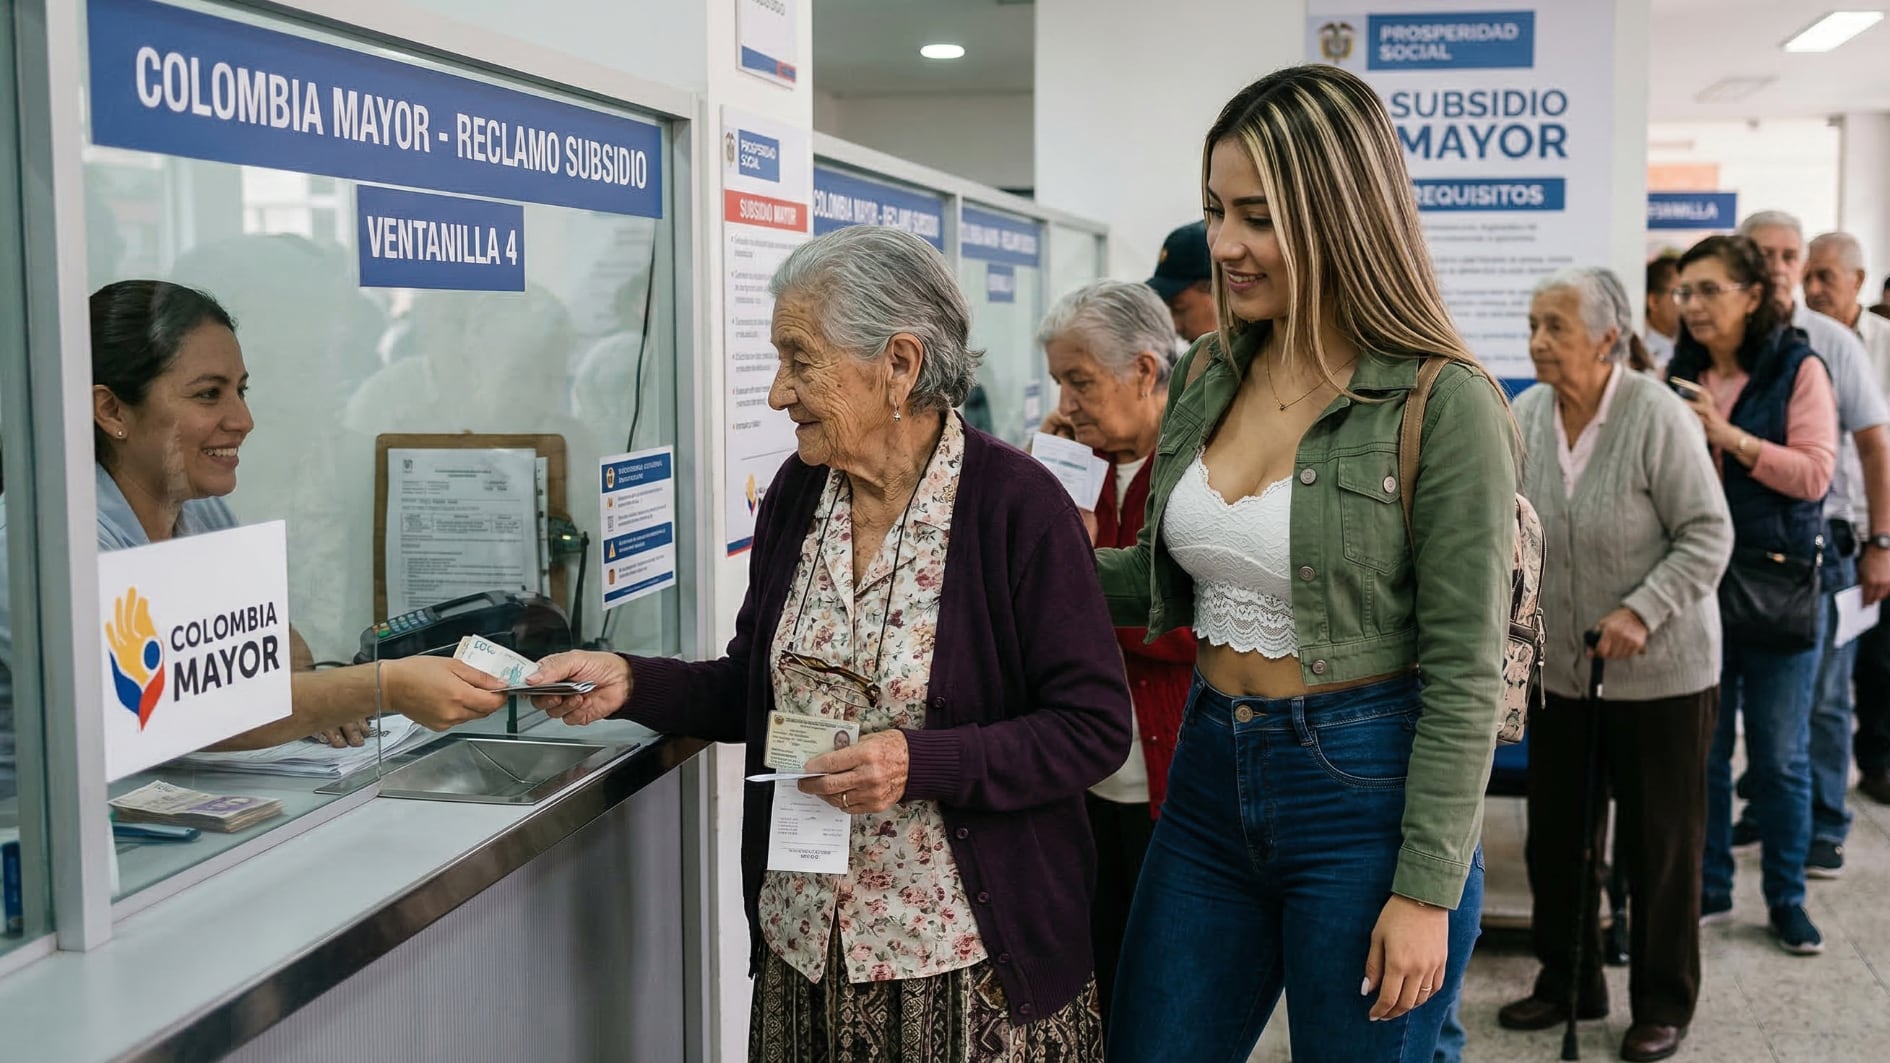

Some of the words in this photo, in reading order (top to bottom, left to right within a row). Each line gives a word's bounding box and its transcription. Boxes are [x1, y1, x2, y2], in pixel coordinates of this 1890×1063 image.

[1379, 44, 1452, 61] SOCIAL
[1380, 23, 1519, 42] PROSPERIDAD
[135, 46, 323, 136] COLOMBIA
[333, 87, 431, 153] MAYOR
[456, 113, 560, 175] RECLAMO
[566, 135, 647, 190] SUBSIDIO
[1391, 90, 1568, 118] SUBSIDIO
[1397, 124, 1568, 159] MAYOR
[367, 216, 501, 265] VENTANILLA
[505, 229, 517, 265] 4
[171, 602, 278, 652] COLOMBIA
[174, 635, 280, 702] MAYOR
